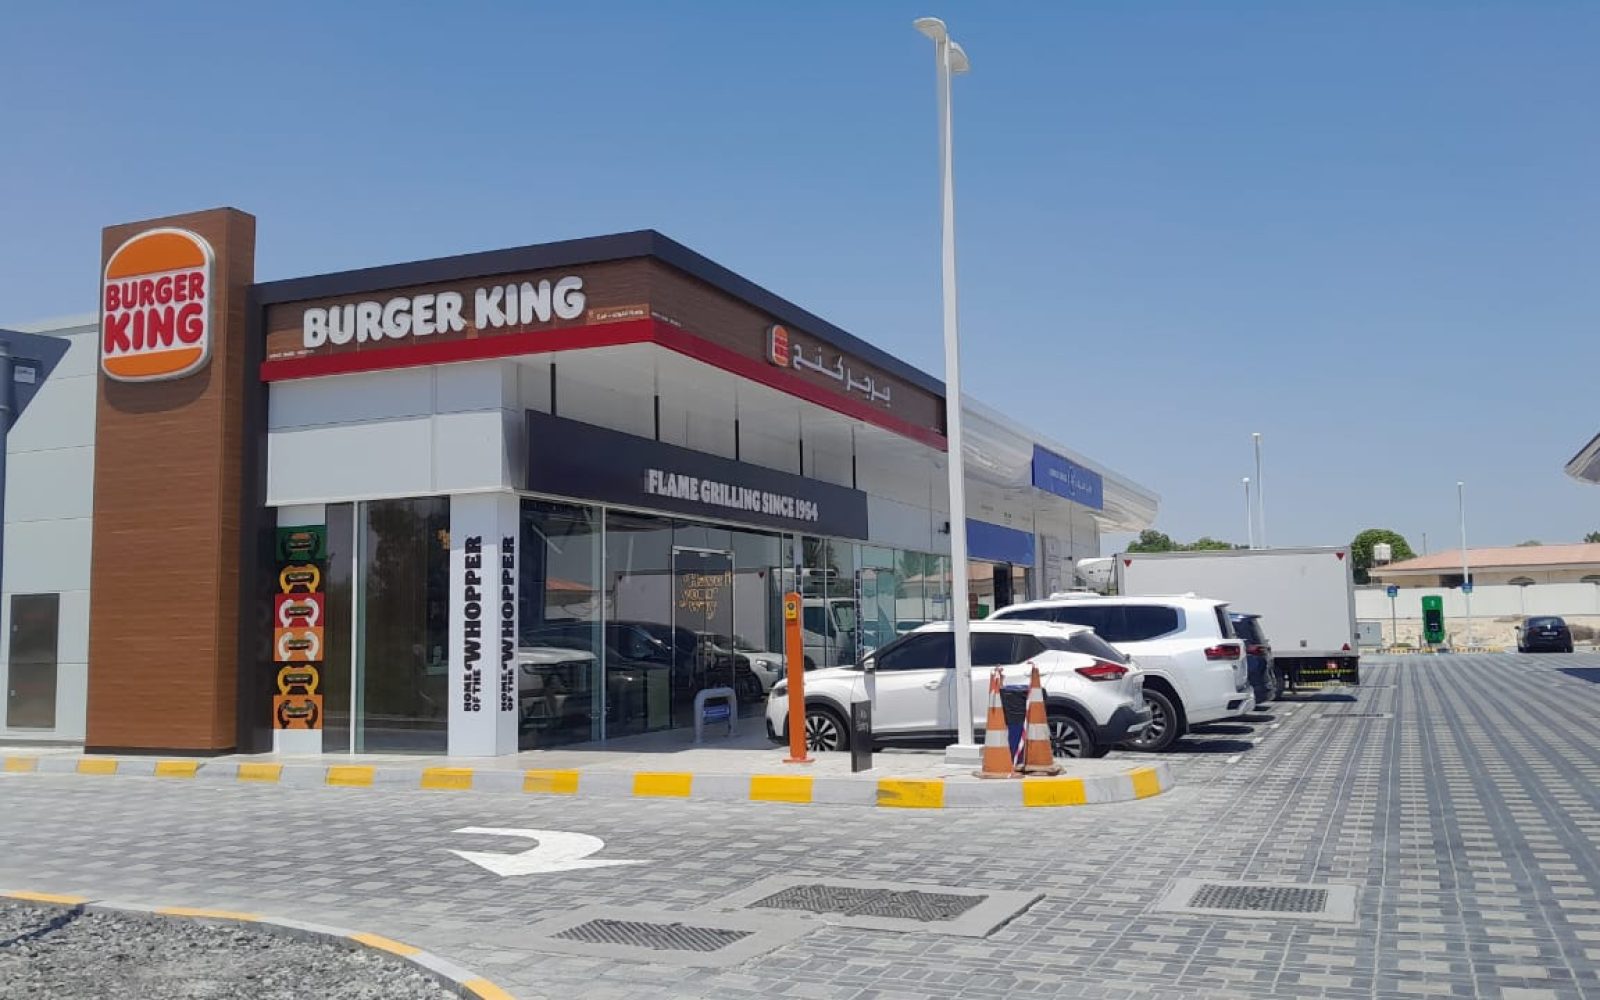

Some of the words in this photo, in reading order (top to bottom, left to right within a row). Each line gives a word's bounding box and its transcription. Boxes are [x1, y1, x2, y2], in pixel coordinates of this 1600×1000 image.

[106, 272, 205, 311] BURGER
[303, 291, 467, 348] BURGER
[474, 275, 586, 330] KING
[104, 303, 204, 354] KING
[645, 469, 700, 501] FLAME
[701, 480, 761, 512] GRILLING
[761, 492, 796, 518] SINCE
[464, 535, 482, 671] WHOPPER
[501, 535, 515, 671] WHOPPER
[464, 674, 472, 712] HOME
[472, 668, 481, 694] THE
[472, 698, 481, 712] OF
[507, 699, 514, 712] OF
